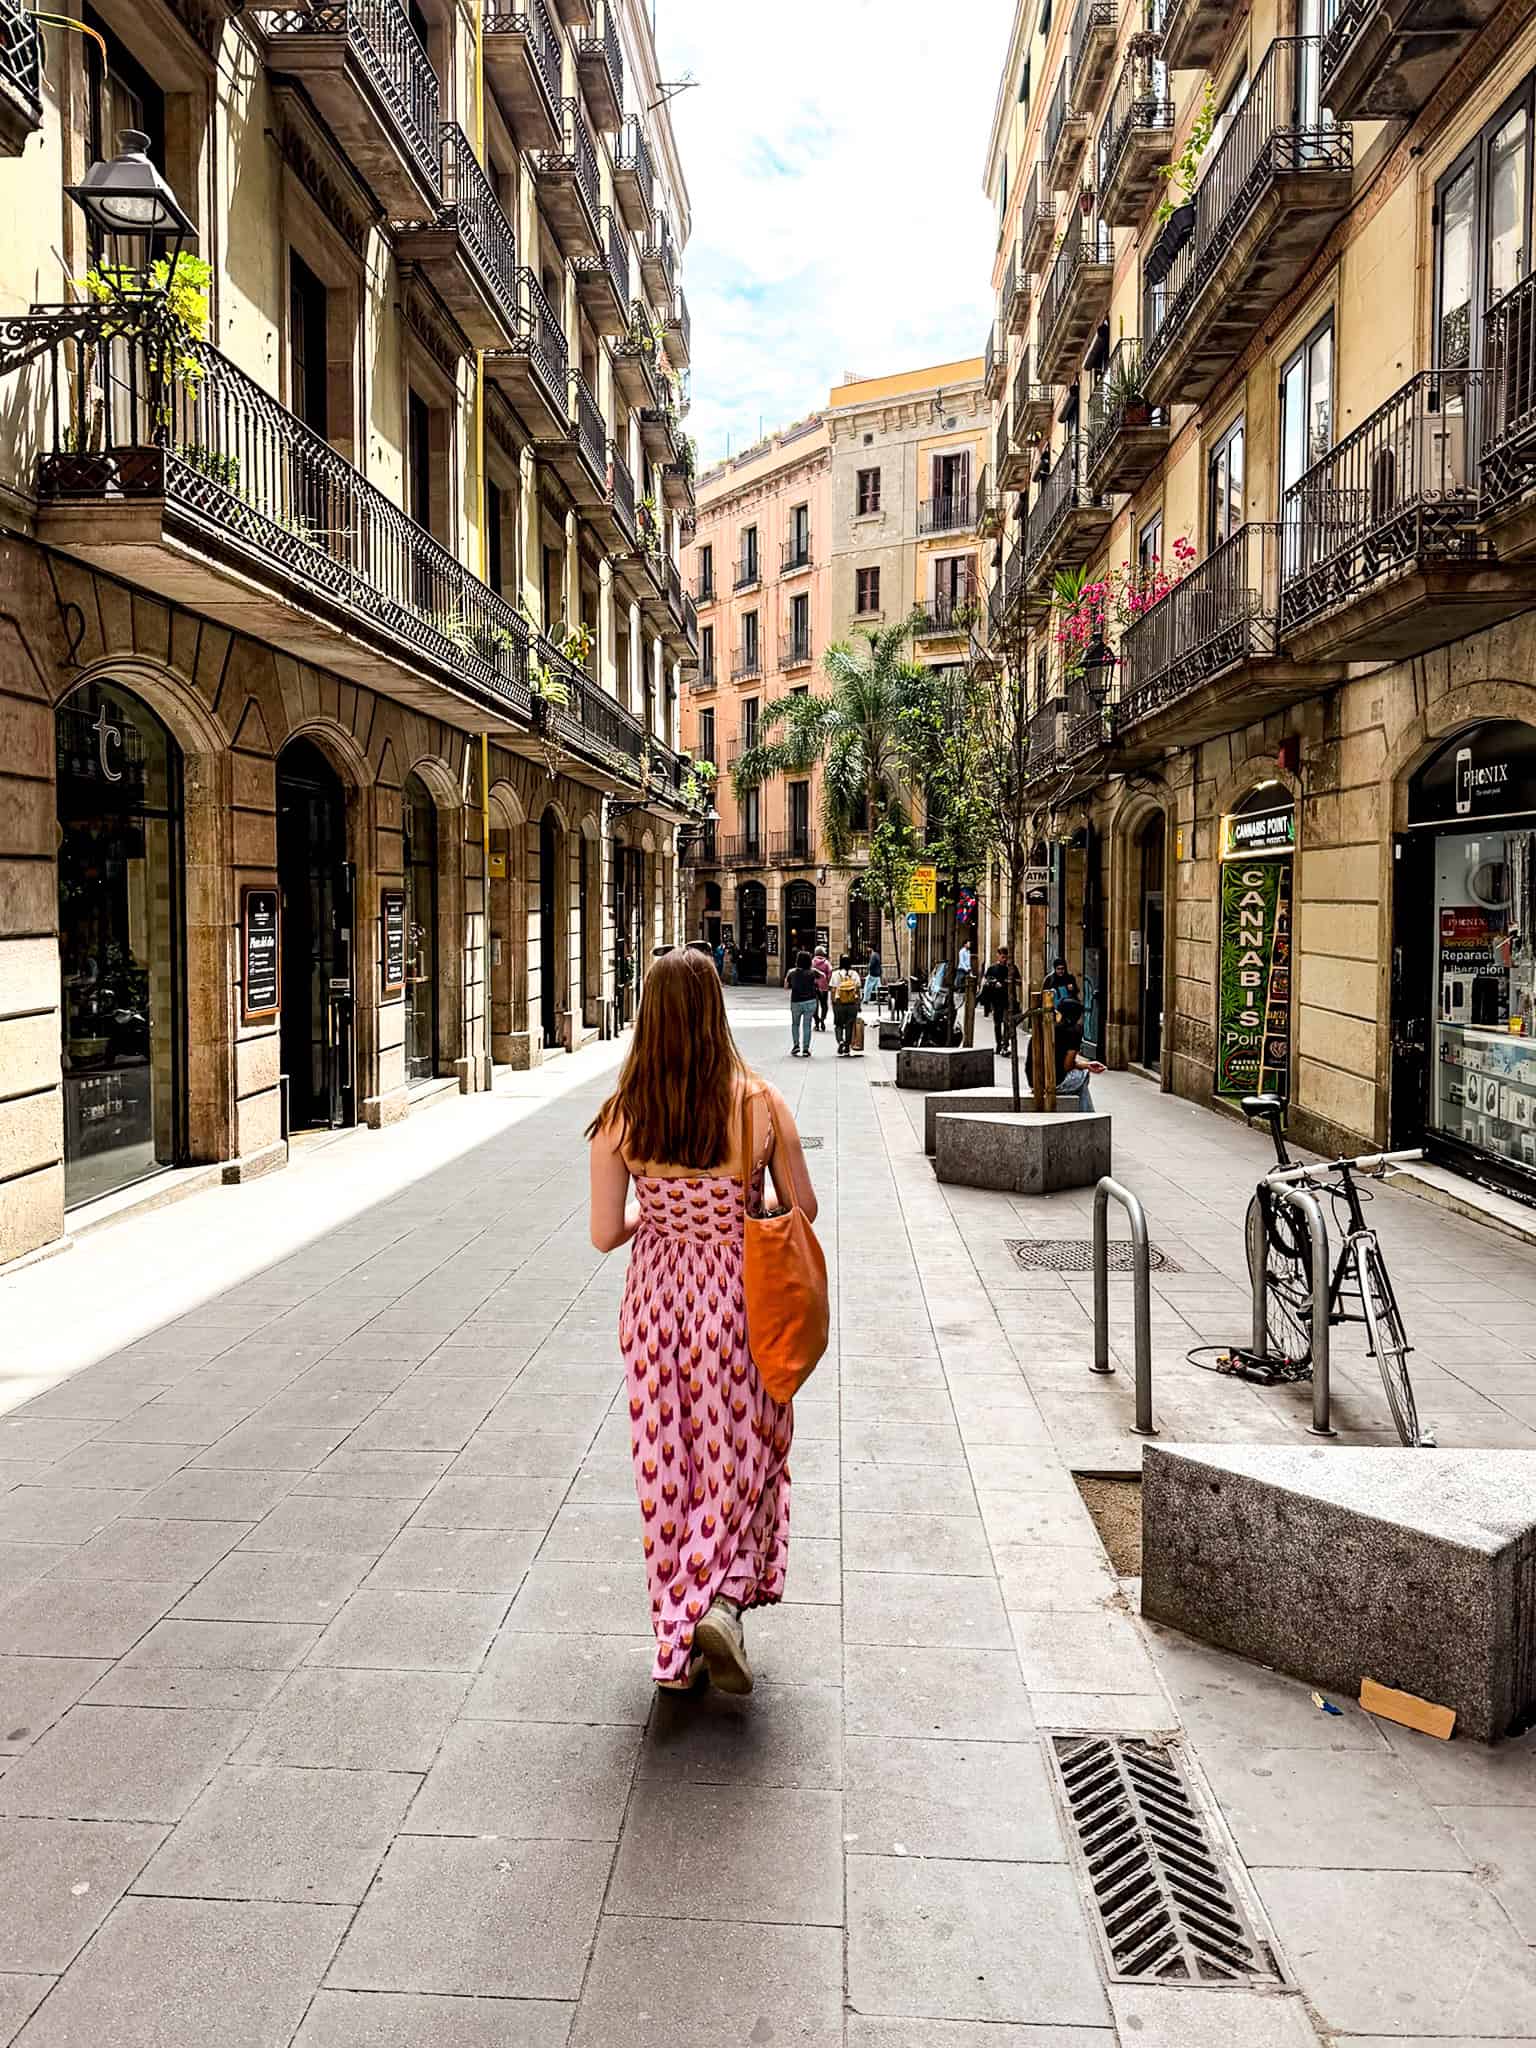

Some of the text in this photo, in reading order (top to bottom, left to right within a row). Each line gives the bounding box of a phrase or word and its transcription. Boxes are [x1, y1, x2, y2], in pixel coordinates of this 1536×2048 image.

[1236, 816, 1288, 839] CANNABIS POINT
[1027, 871, 1047, 880] ATM
[1238, 871, 1265, 1027] CANNABIS
[1441, 949, 1493, 962] Reparaci
[1226, 1031, 1265, 1046] Poin
